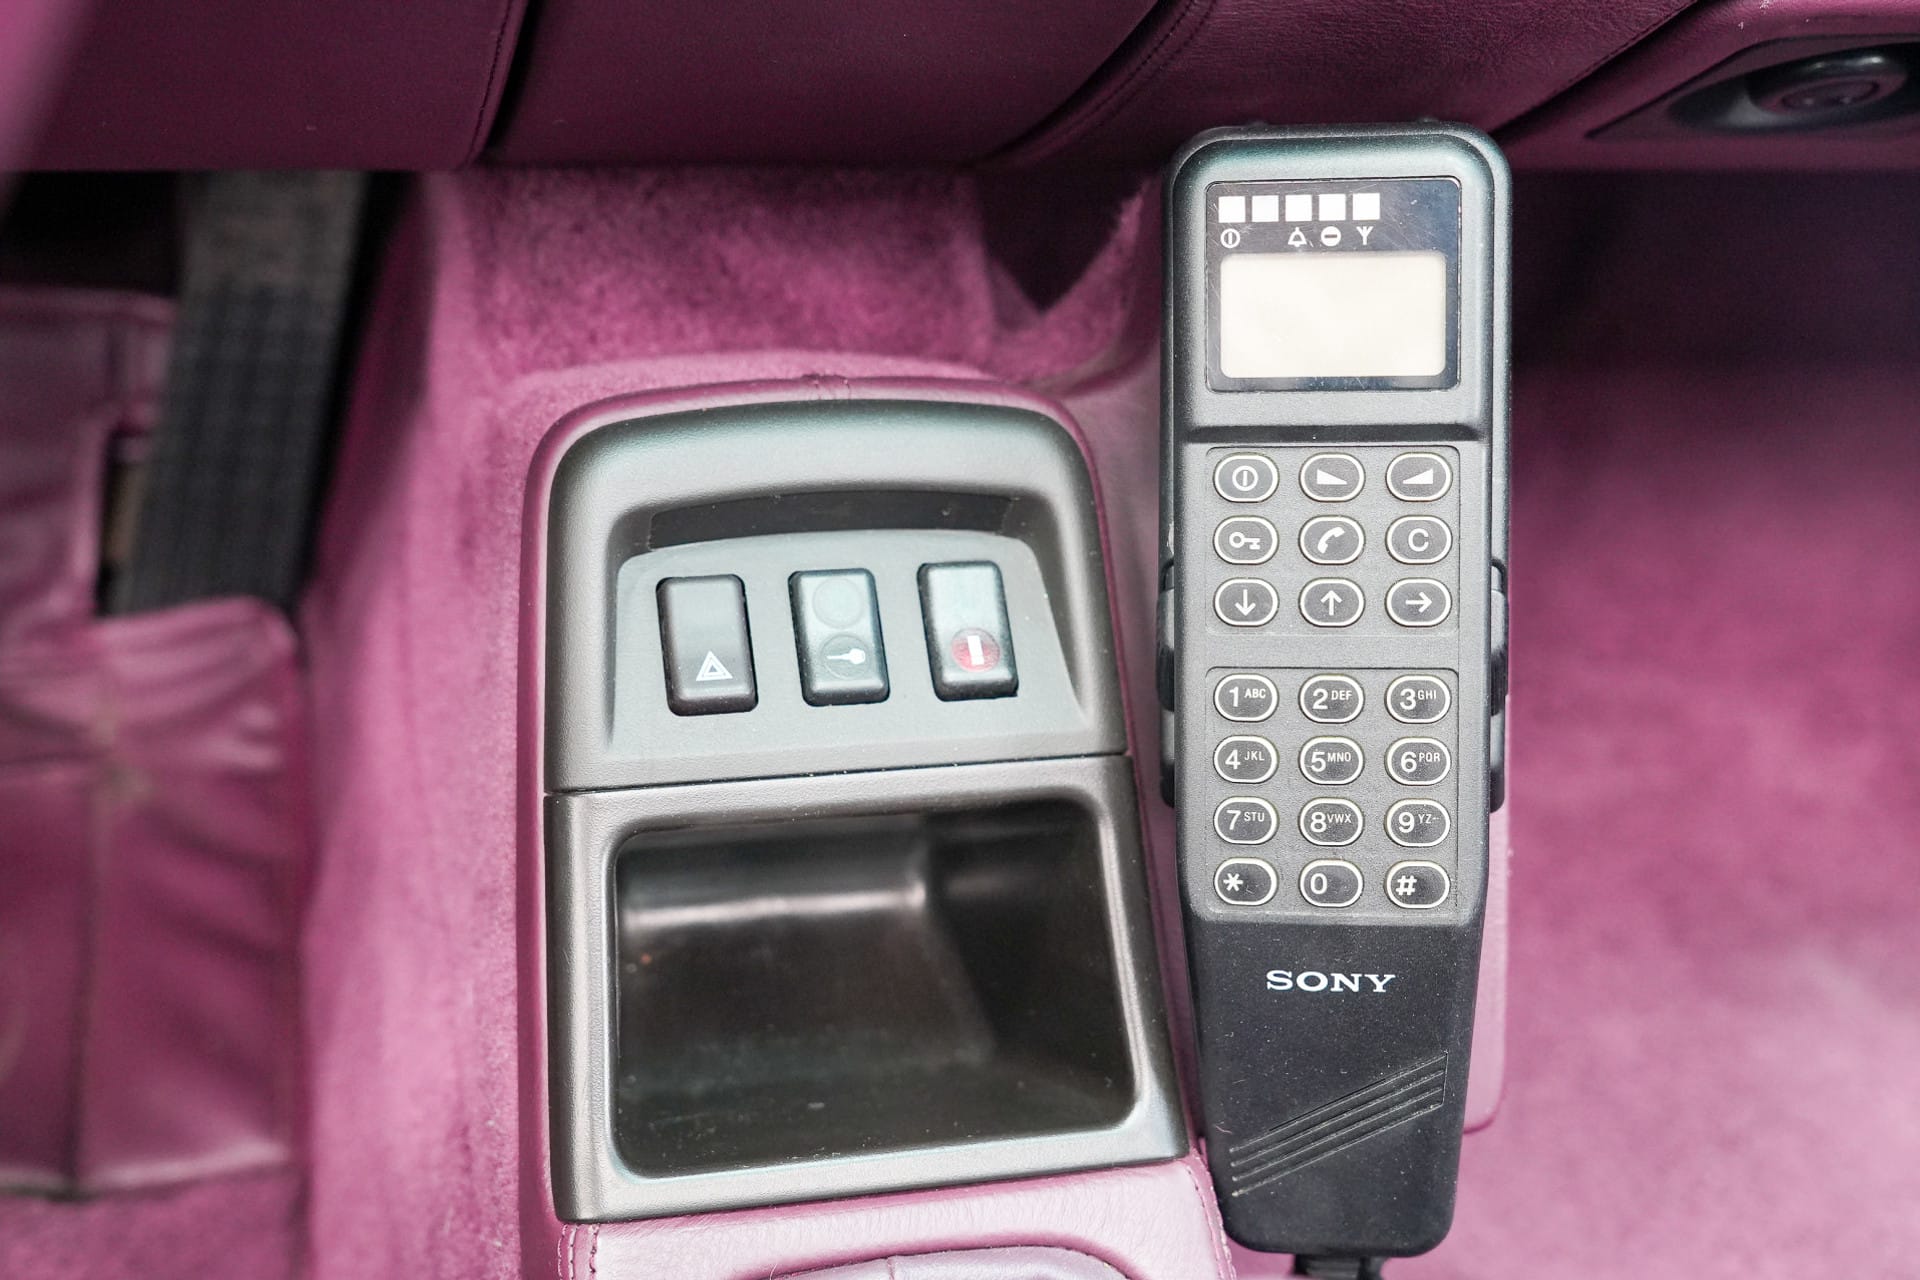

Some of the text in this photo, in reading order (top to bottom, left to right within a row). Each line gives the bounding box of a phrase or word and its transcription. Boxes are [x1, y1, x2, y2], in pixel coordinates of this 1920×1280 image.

[1408, 528, 1430, 552] C
[1229, 686, 1266, 707] 1 ABC
[1312, 689, 1352, 709] 2 DEF
[1399, 689, 1437, 710] 3 GHI
[1225, 750, 1265, 770] 4 JKL
[1310, 751, 1351, 772] 5 MNO
[1400, 752, 1440, 772] 6 PQR
[1226, 810, 1265, 830] 7 STU
[1310, 812, 1352, 832] 8 VWX
[1398, 812, 1415, 833] 9
[1310, 873, 1327, 894] 0
[1266, 969, 1396, 993] SONY
